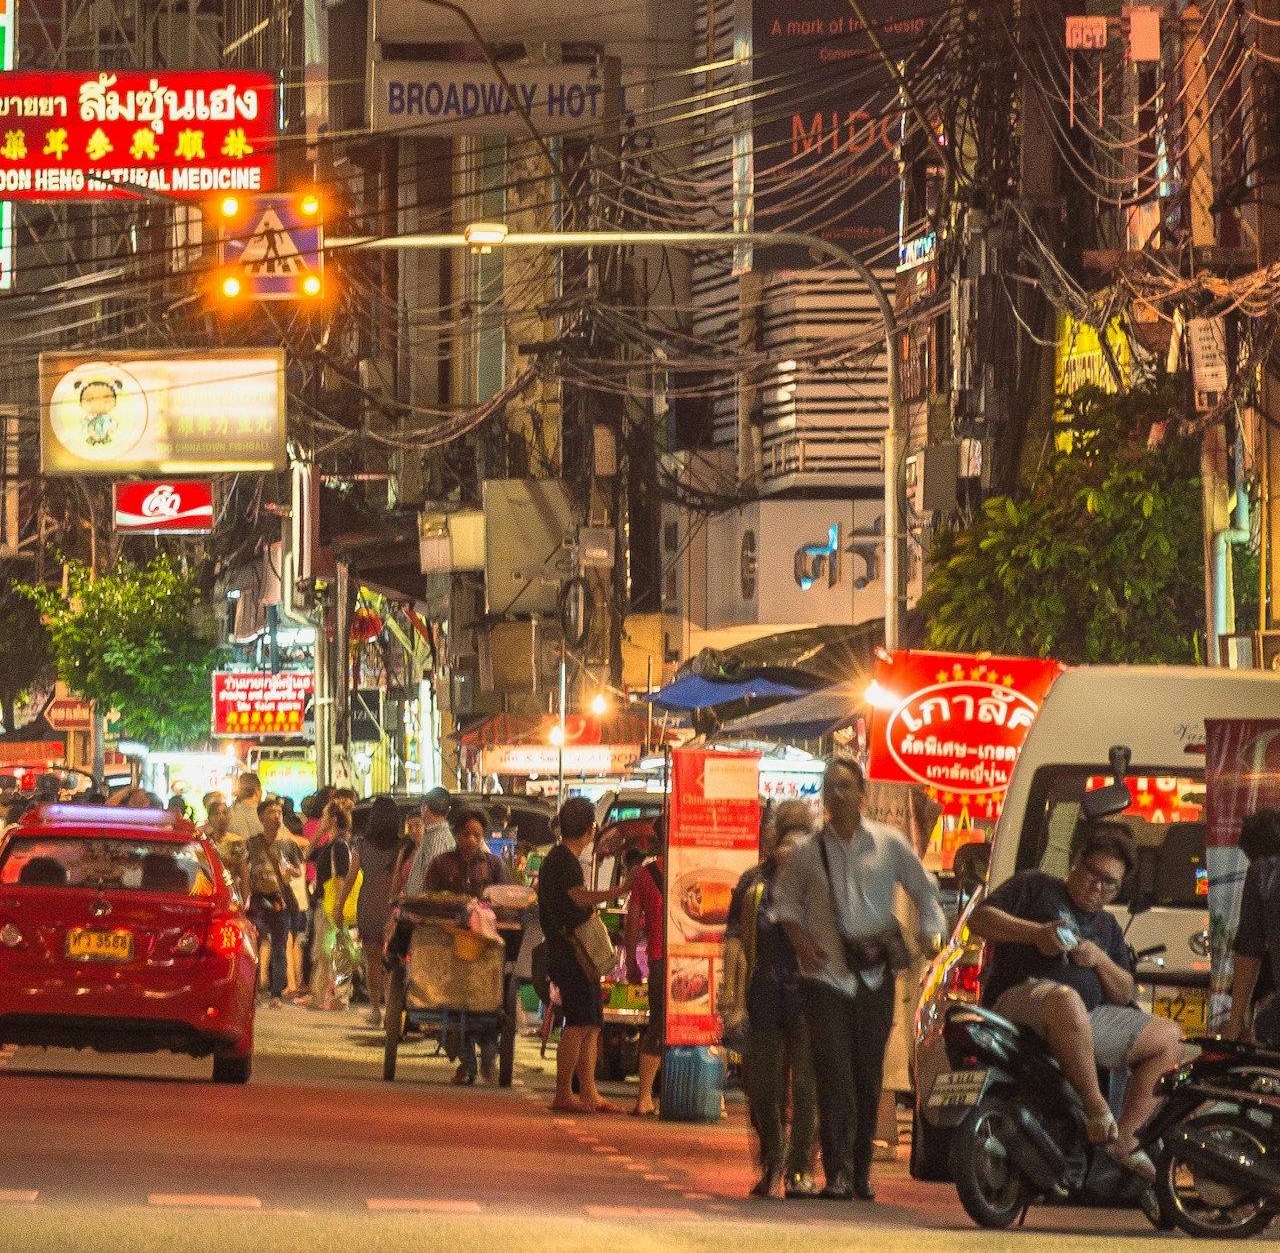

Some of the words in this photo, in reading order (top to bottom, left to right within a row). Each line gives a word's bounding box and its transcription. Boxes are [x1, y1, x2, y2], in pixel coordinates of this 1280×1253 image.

[79, 72, 259, 134] ลิ้มซุ่นเฮง
[388, 81, 538, 116] BROADWAY
[547, 83, 633, 118] HOTL
[34, 169, 85, 191] HENG
[172, 167, 262, 191] MEDICINE
